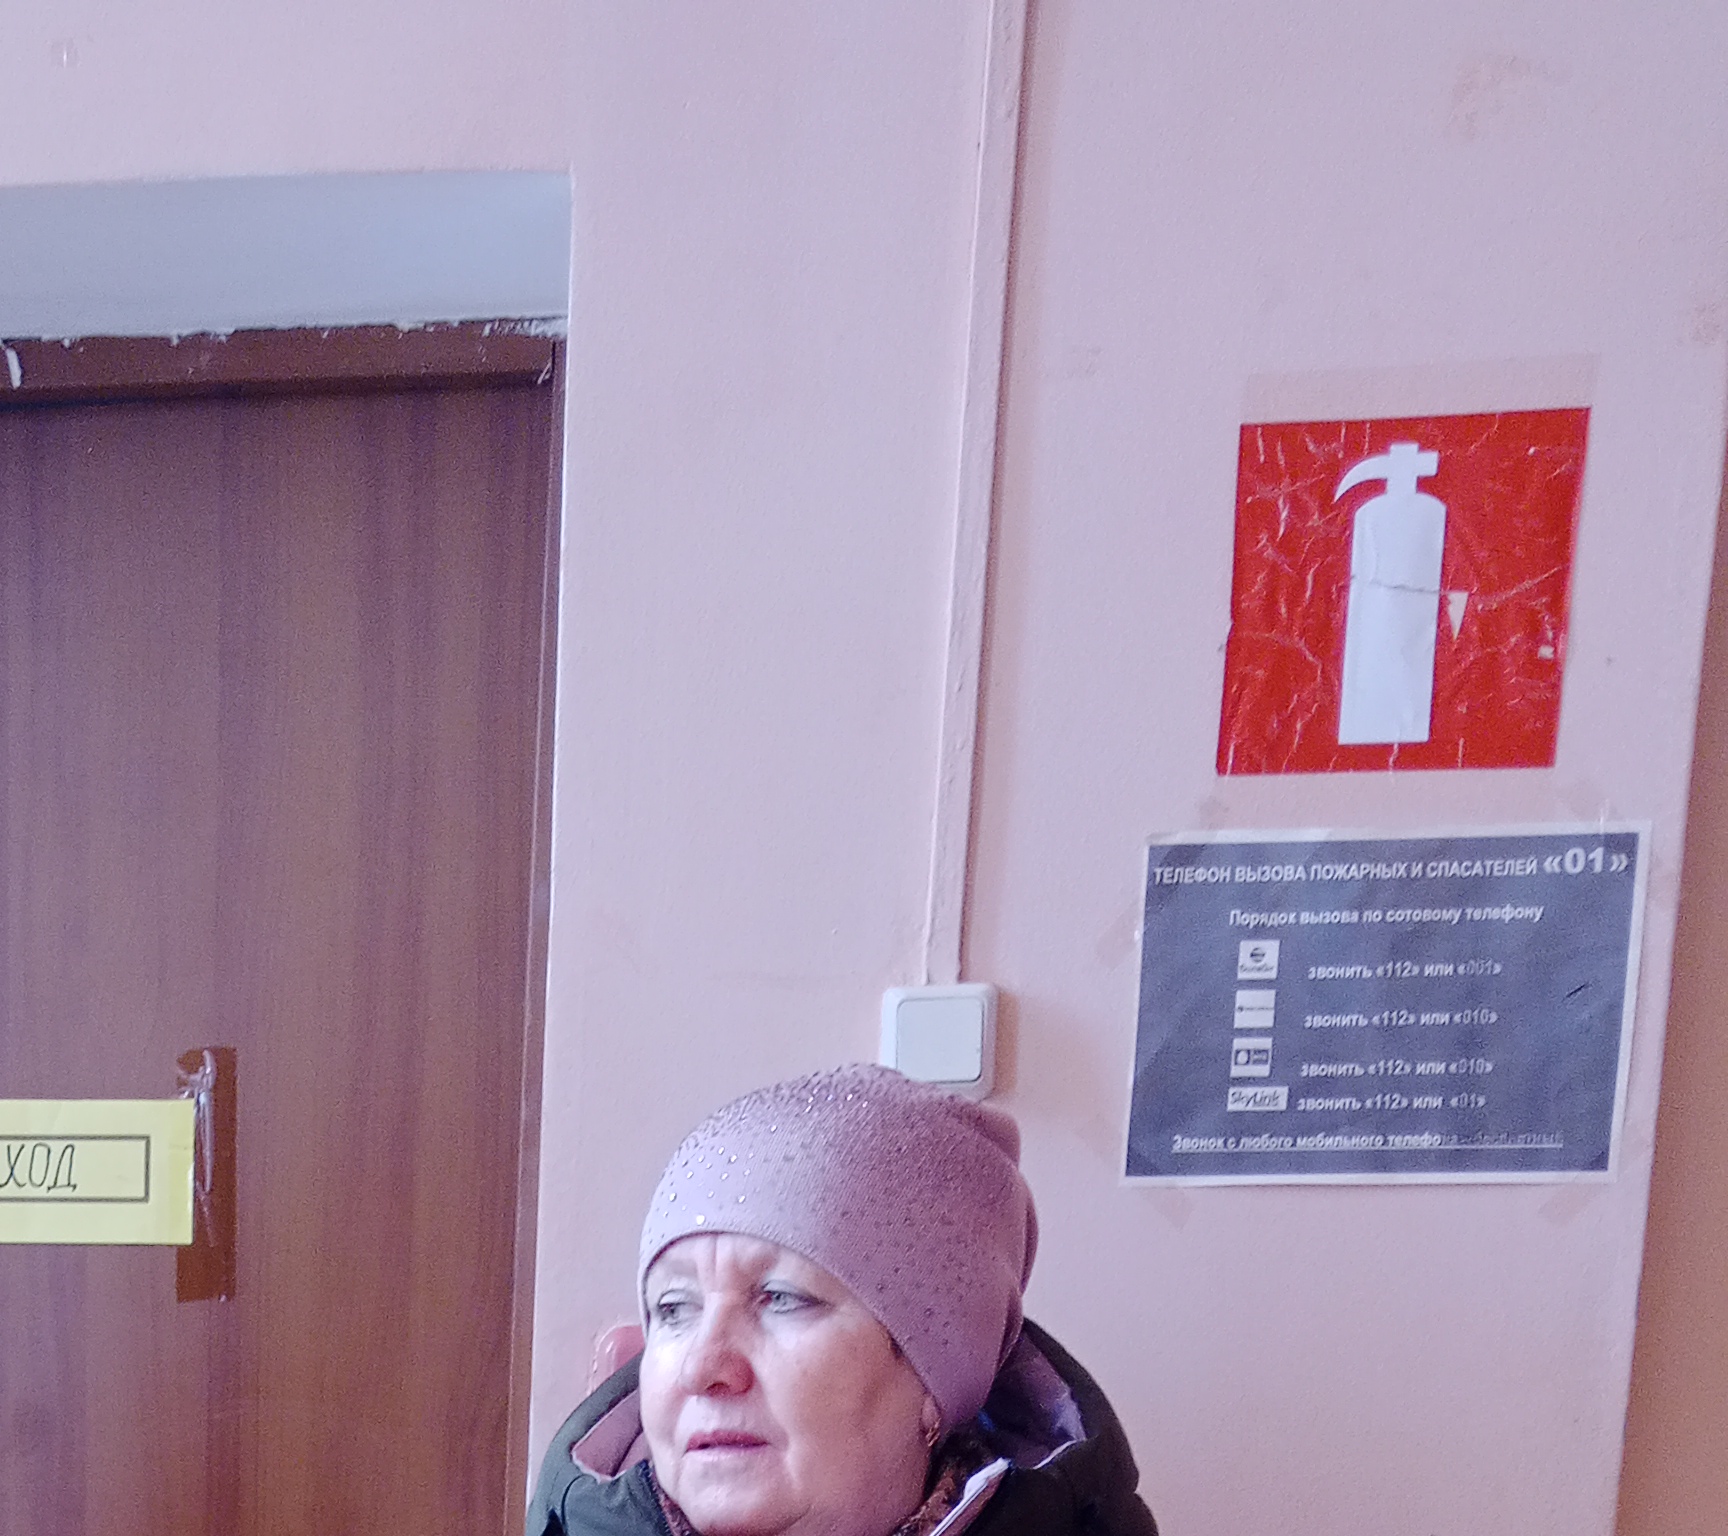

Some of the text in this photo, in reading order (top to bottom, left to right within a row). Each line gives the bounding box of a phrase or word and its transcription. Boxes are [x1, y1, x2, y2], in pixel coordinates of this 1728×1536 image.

[1154, 847, 1629, 884] ТЕЛЕФОН ВЫЗОВА ПОЖАРНЫХ И СПАСАТЕЛЕЙ «01»
[1229, 903, 1545, 929] Порядок вызова по сотовому телефону
[1308, 964, 1373, 981] звонить
[1424, 962, 1455, 977] или
[1304, 1013, 1369, 1029] звонить
[1420, 1012, 1451, 1026] или
[1301, 1062, 1365, 1078] звонить
[1415, 1060, 1447, 1076] или
[1297, 1096, 1362, 1112] звонить
[1412, 1095, 1444, 1110] или
[1172, 1133, 1225, 1150] Звонок
[1239, 1132, 1293, 1149] любого
[1296, 1131, 1384, 1149] мобильного
